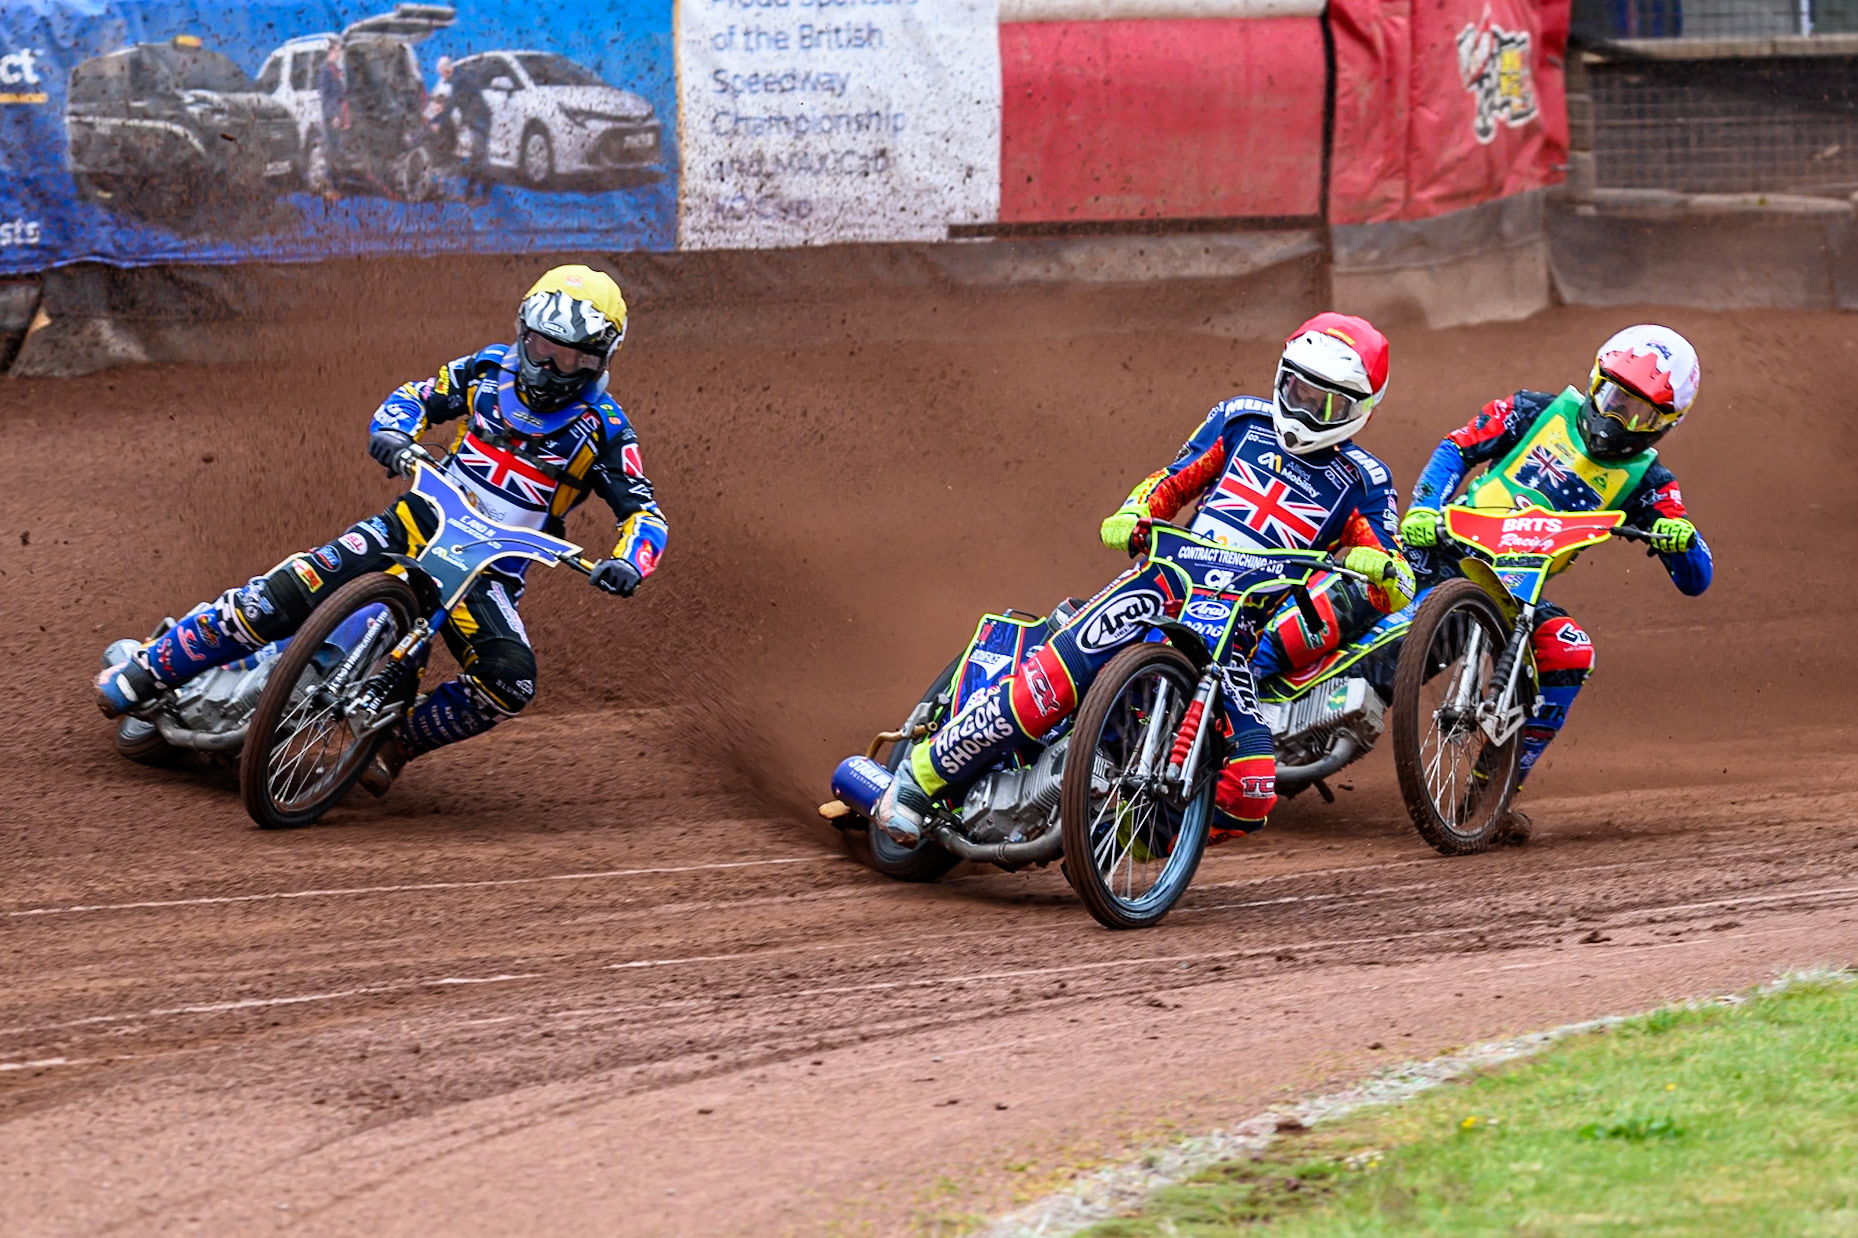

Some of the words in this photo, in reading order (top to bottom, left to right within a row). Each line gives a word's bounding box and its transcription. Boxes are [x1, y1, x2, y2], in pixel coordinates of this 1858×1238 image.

[711, 25, 736, 50] of
[742, 25, 790, 52] the
[799, 22, 884, 49] British
[711, 69, 851, 97] Speedway
[711, 111, 907, 138] Championship
[1285, 461, 1312, 481] Allied
[1345, 449, 1389, 486] DAD
[1280, 468, 1319, 498] Mobility
[1501, 517, 1563, 533] BRTS
[1497, 533, 1554, 551] Racing
[1177, 545, 1220, 562] CONTRACT
[1218, 550, 1267, 571] TRENCHING
[1090, 595, 1151, 647] Arai
[1192, 603, 1226, 615] Arai
[935, 696, 1001, 758] HAGON
[940, 716, 1014, 774] SHOCKS
